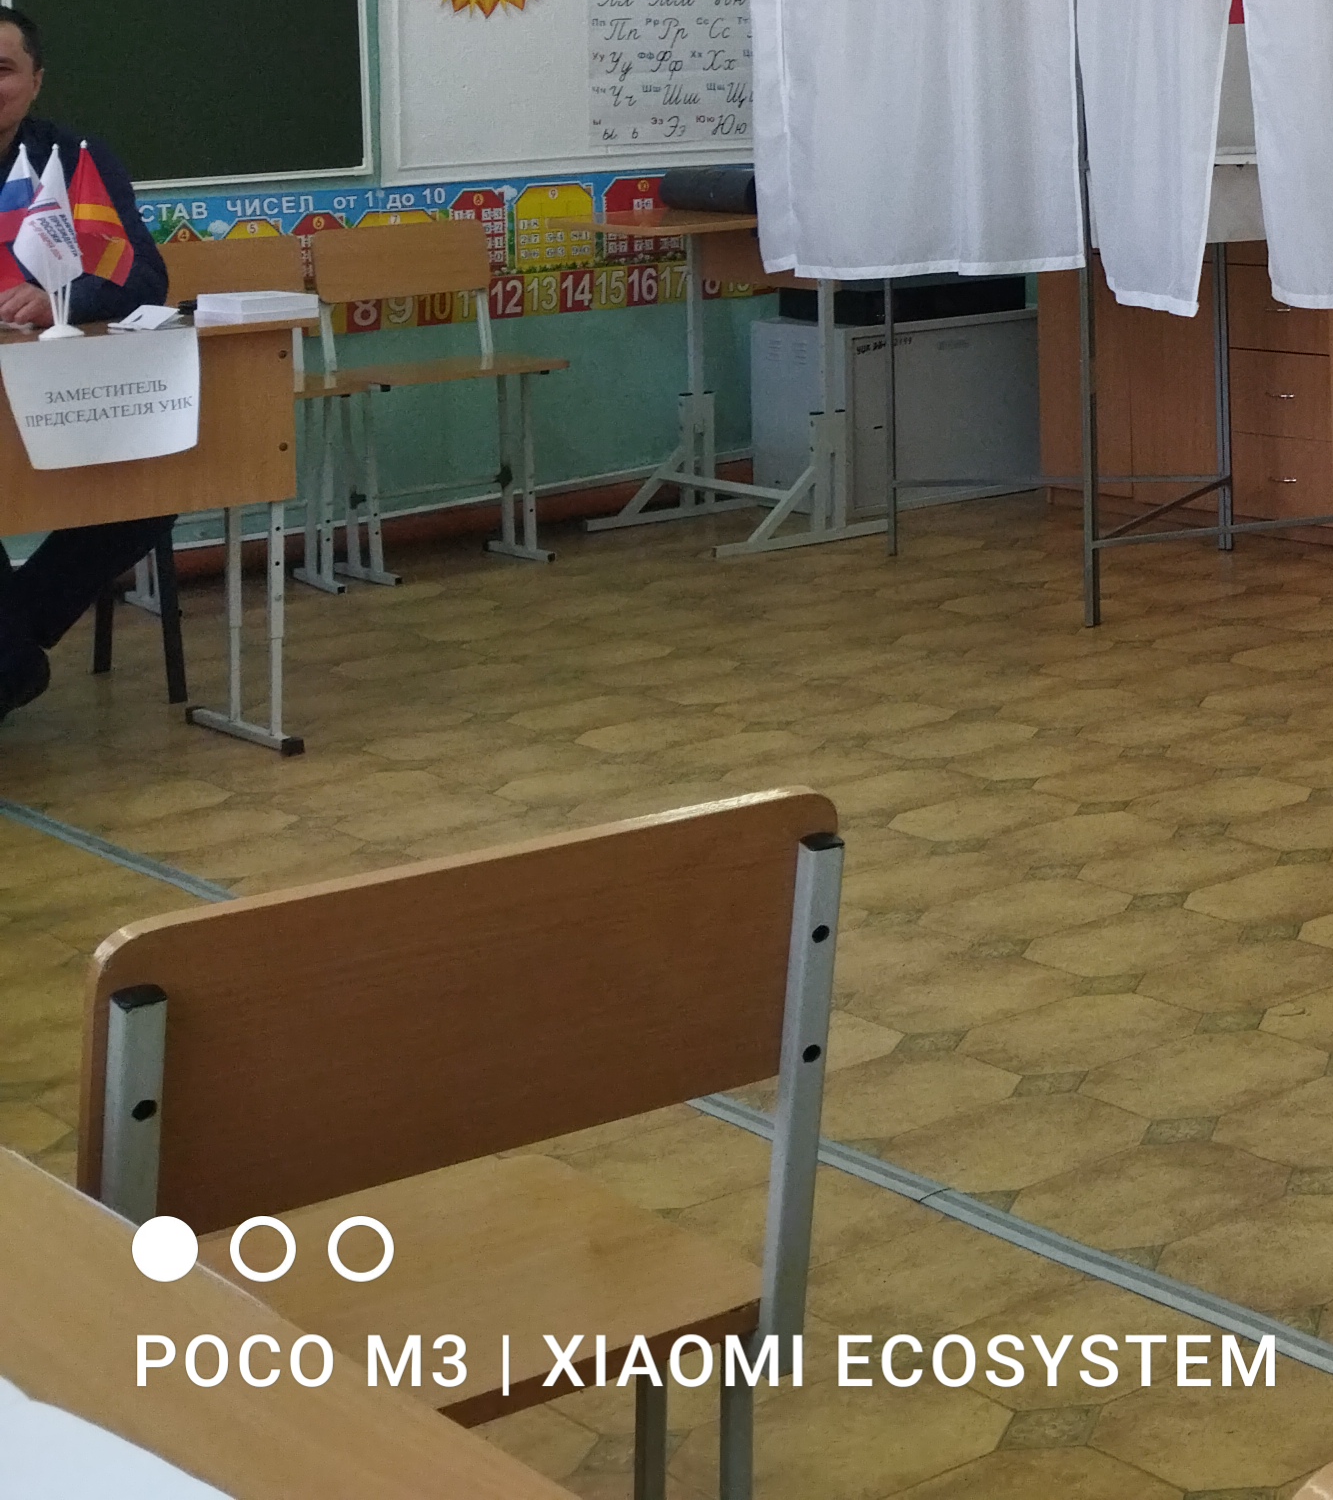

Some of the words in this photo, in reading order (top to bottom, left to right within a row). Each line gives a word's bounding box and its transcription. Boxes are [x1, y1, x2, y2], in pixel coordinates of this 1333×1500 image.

[726, 82, 753, 108] Щ
[226, 195, 314, 217] ЧИСЕЛ
[333, 196, 357, 209] от
[386, 192, 415, 209] до
[422, 187, 446, 203] 10
[490, 280, 522, 316] 12
[527, 275, 557, 311] 13
[562, 270, 592, 307] 14
[595, 271, 626, 304] 15
[628, 267, 658, 302] 16
[660, 265, 688, 299] 17
[45, 380, 167, 404] ЗАМЕСТИТЕЛЬ
[25, 402, 154, 427] ПРЕДСЕДАТЕЛЯ
[158, 396, 193, 413] УИК
